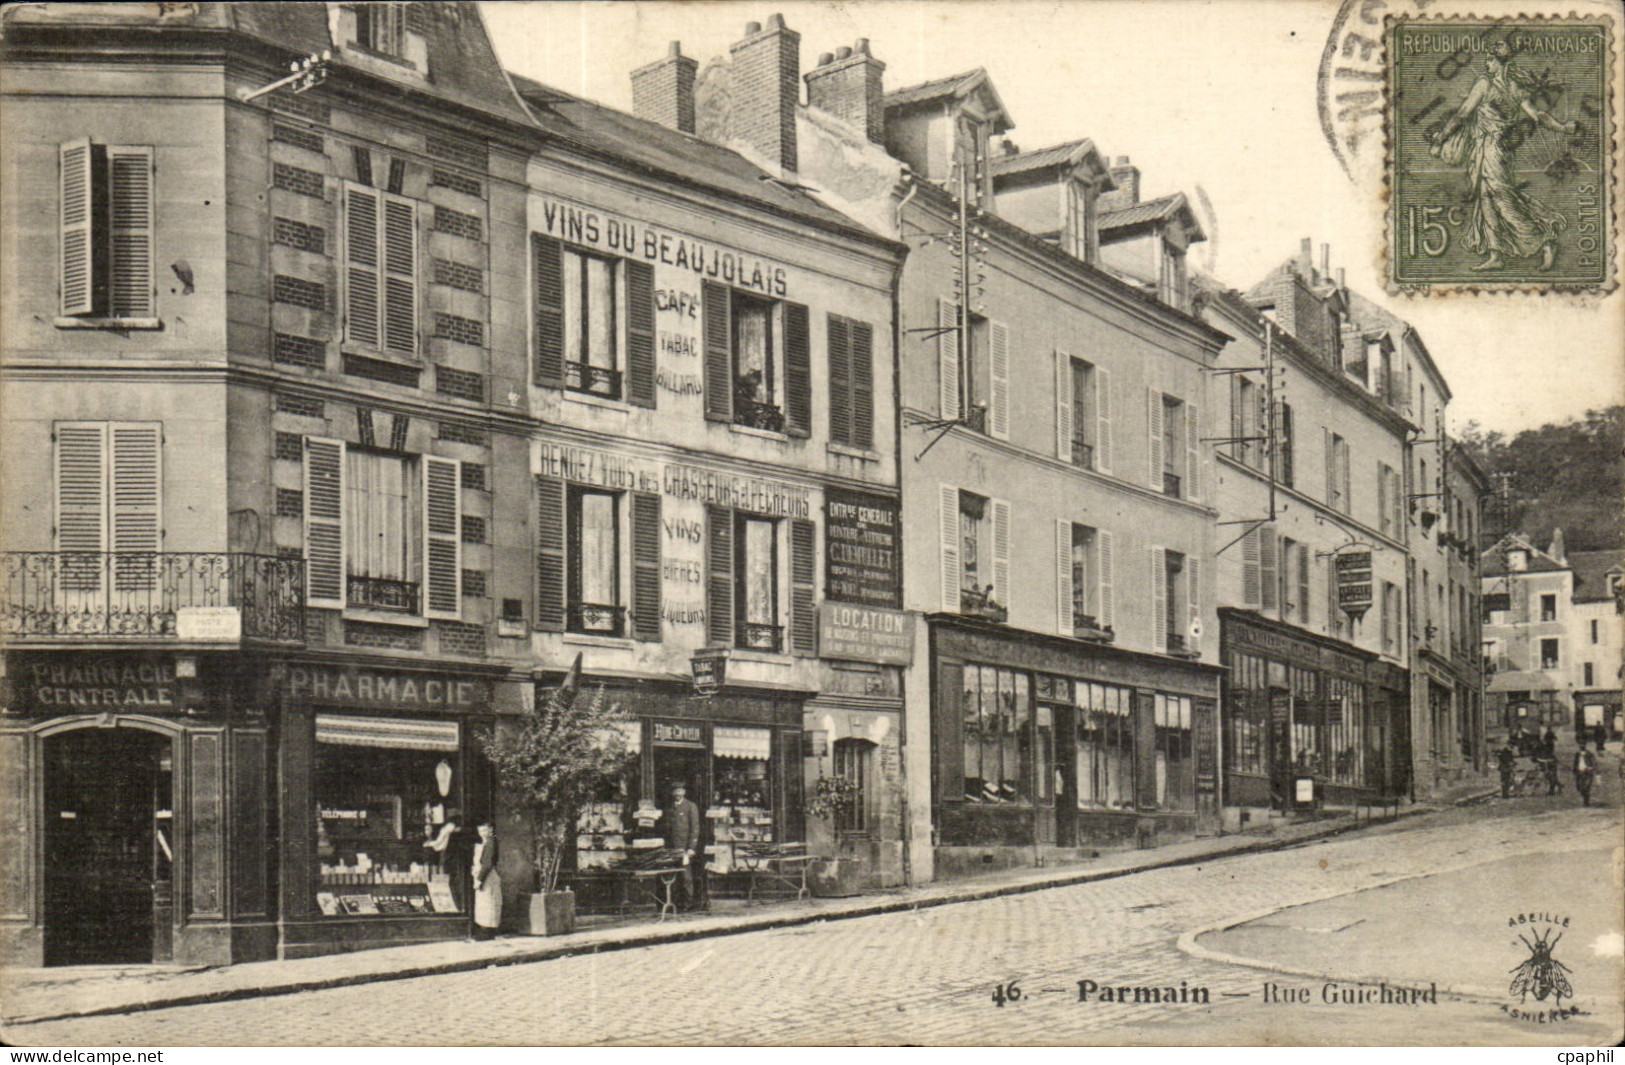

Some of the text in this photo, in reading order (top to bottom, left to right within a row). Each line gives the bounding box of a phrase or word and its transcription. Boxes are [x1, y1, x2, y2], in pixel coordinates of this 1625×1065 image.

[543, 200, 788, 297] VINS DU BEAUJOLAIS
[660, 332, 698, 357] TABAC
[540, 443, 595, 482] RENDEZ
[600, 452, 635, 489] VOUS
[663, 464, 739, 508] CHASSEURS
[663, 518, 702, 544] VINS
[833, 607, 904, 633] LOCATION
[33, 662, 175, 684] PHARMACIE
[39, 686, 173, 706] CENTRALE
[290, 668, 474, 705] PHARMACIE
